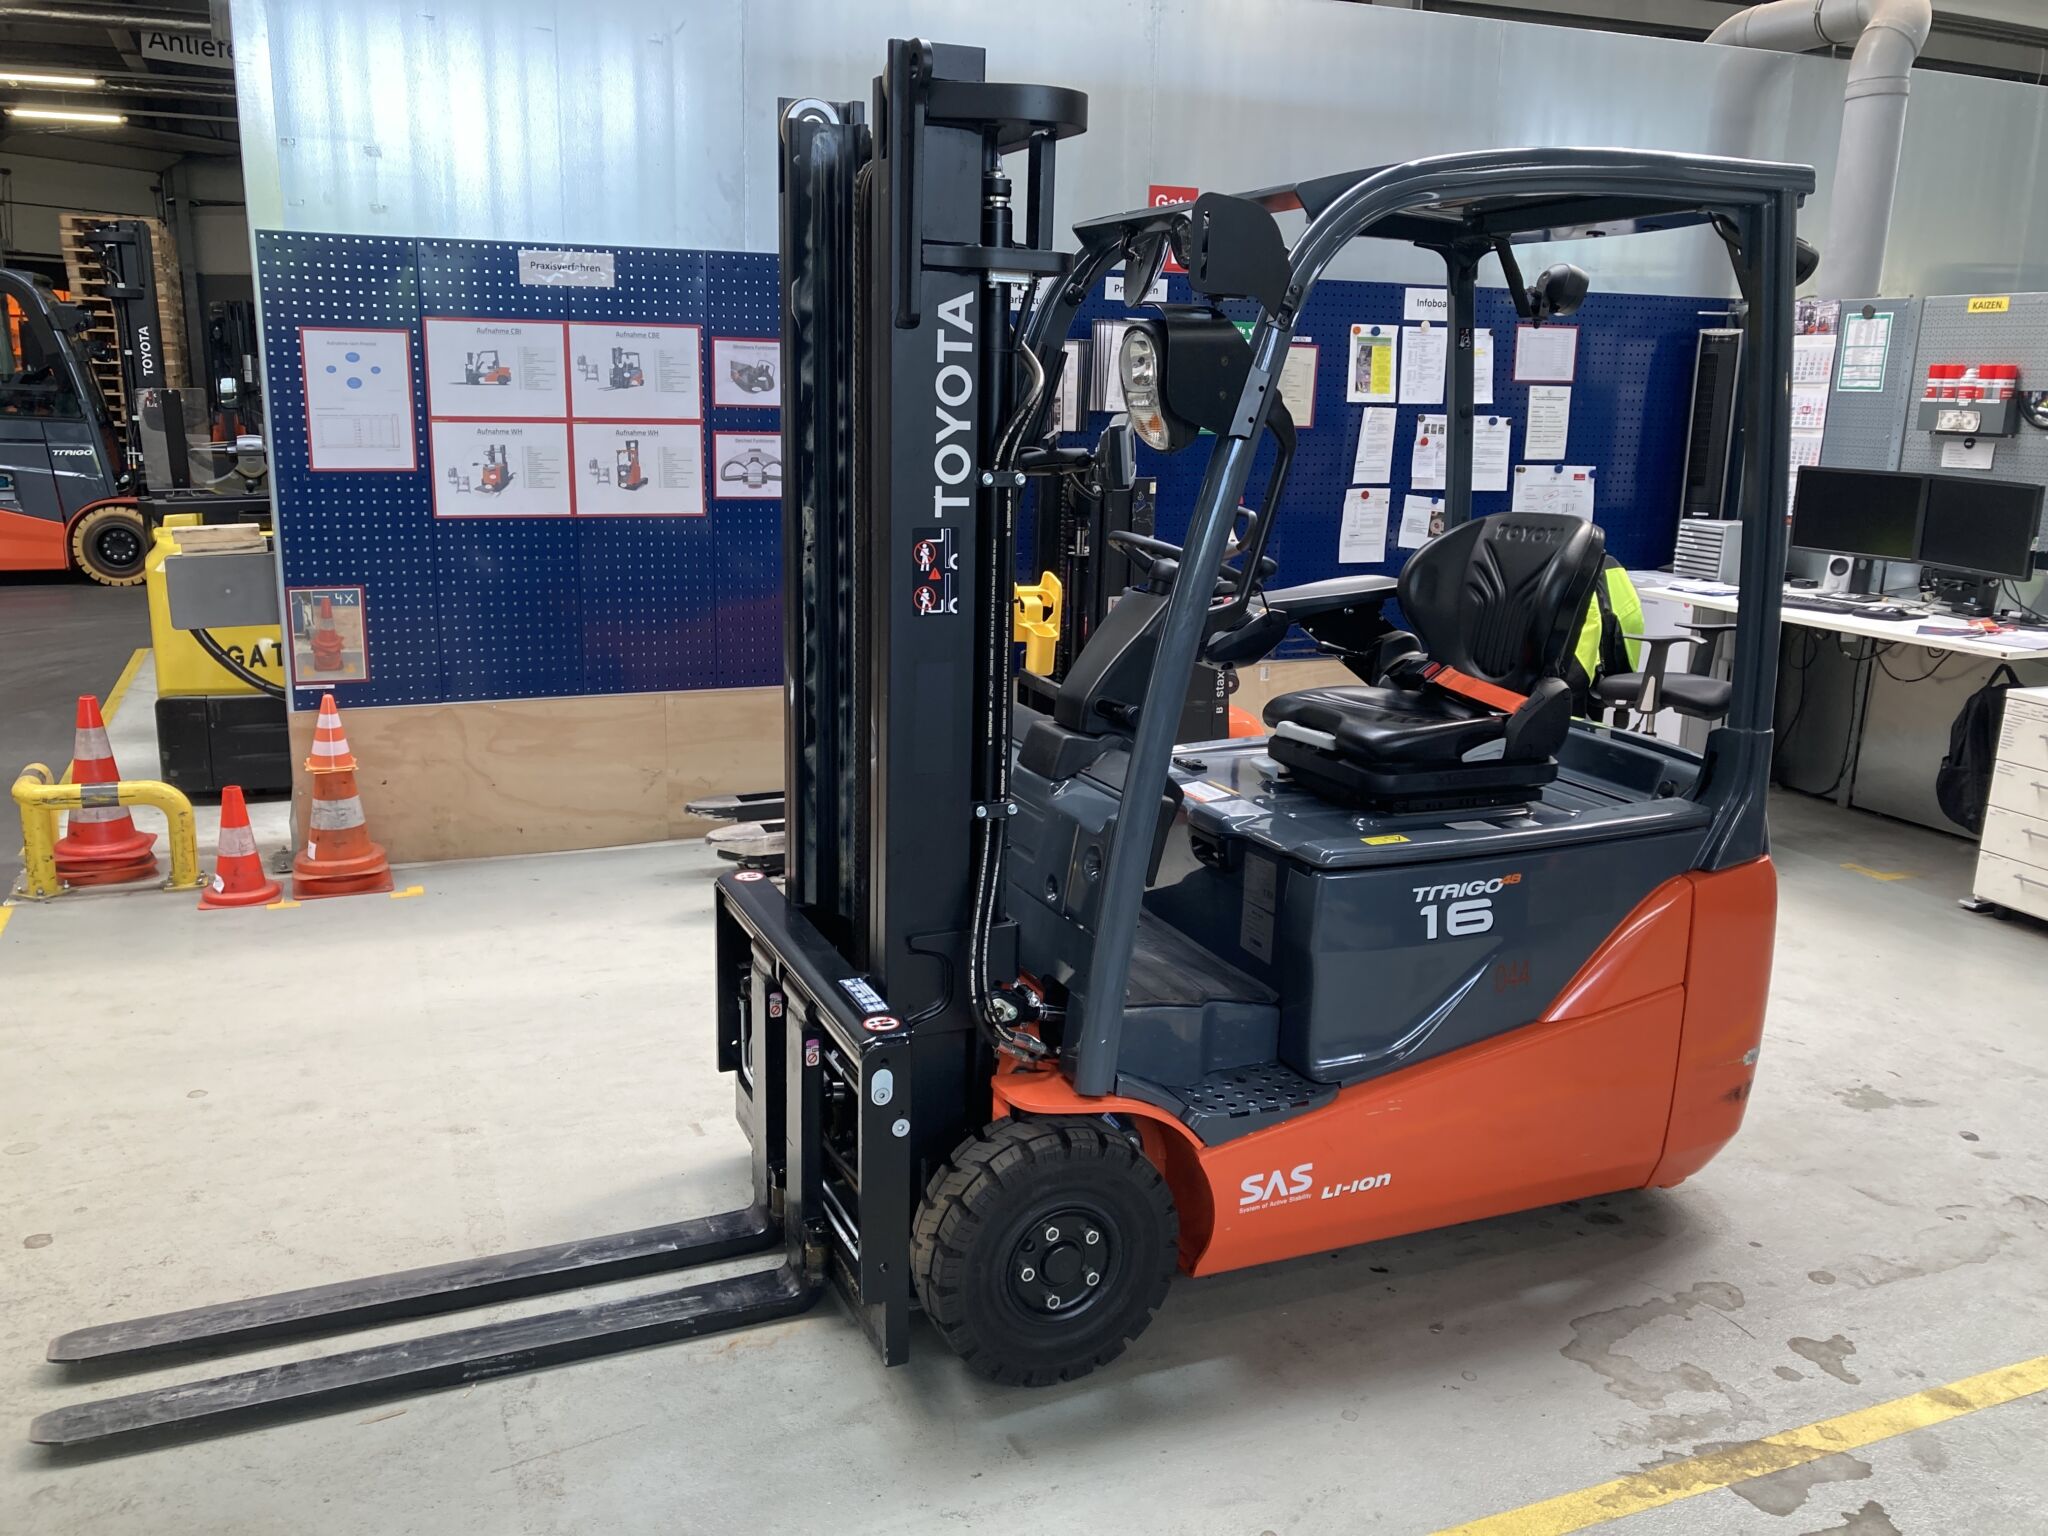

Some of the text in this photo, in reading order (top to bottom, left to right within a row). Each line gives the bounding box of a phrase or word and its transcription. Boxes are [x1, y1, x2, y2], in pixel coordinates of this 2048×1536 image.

[530, 261, 600, 272] Praxisverfahren
[1972, 301, 2002, 310] KAIZEN
[476, 327, 509, 335] Aufnahme
[138, 326, 154, 376] TOYOTA
[934, 291, 974, 518] TOYOTA
[476, 428, 509, 436] Aufnahme
[1216, 669, 1225, 698] stax
[1420, 898, 1494, 940] 16
[1240, 1162, 1313, 1206] SAS
[1239, 1205, 1261, 1214] System
[1270, 1199, 1288, 1207] Active
